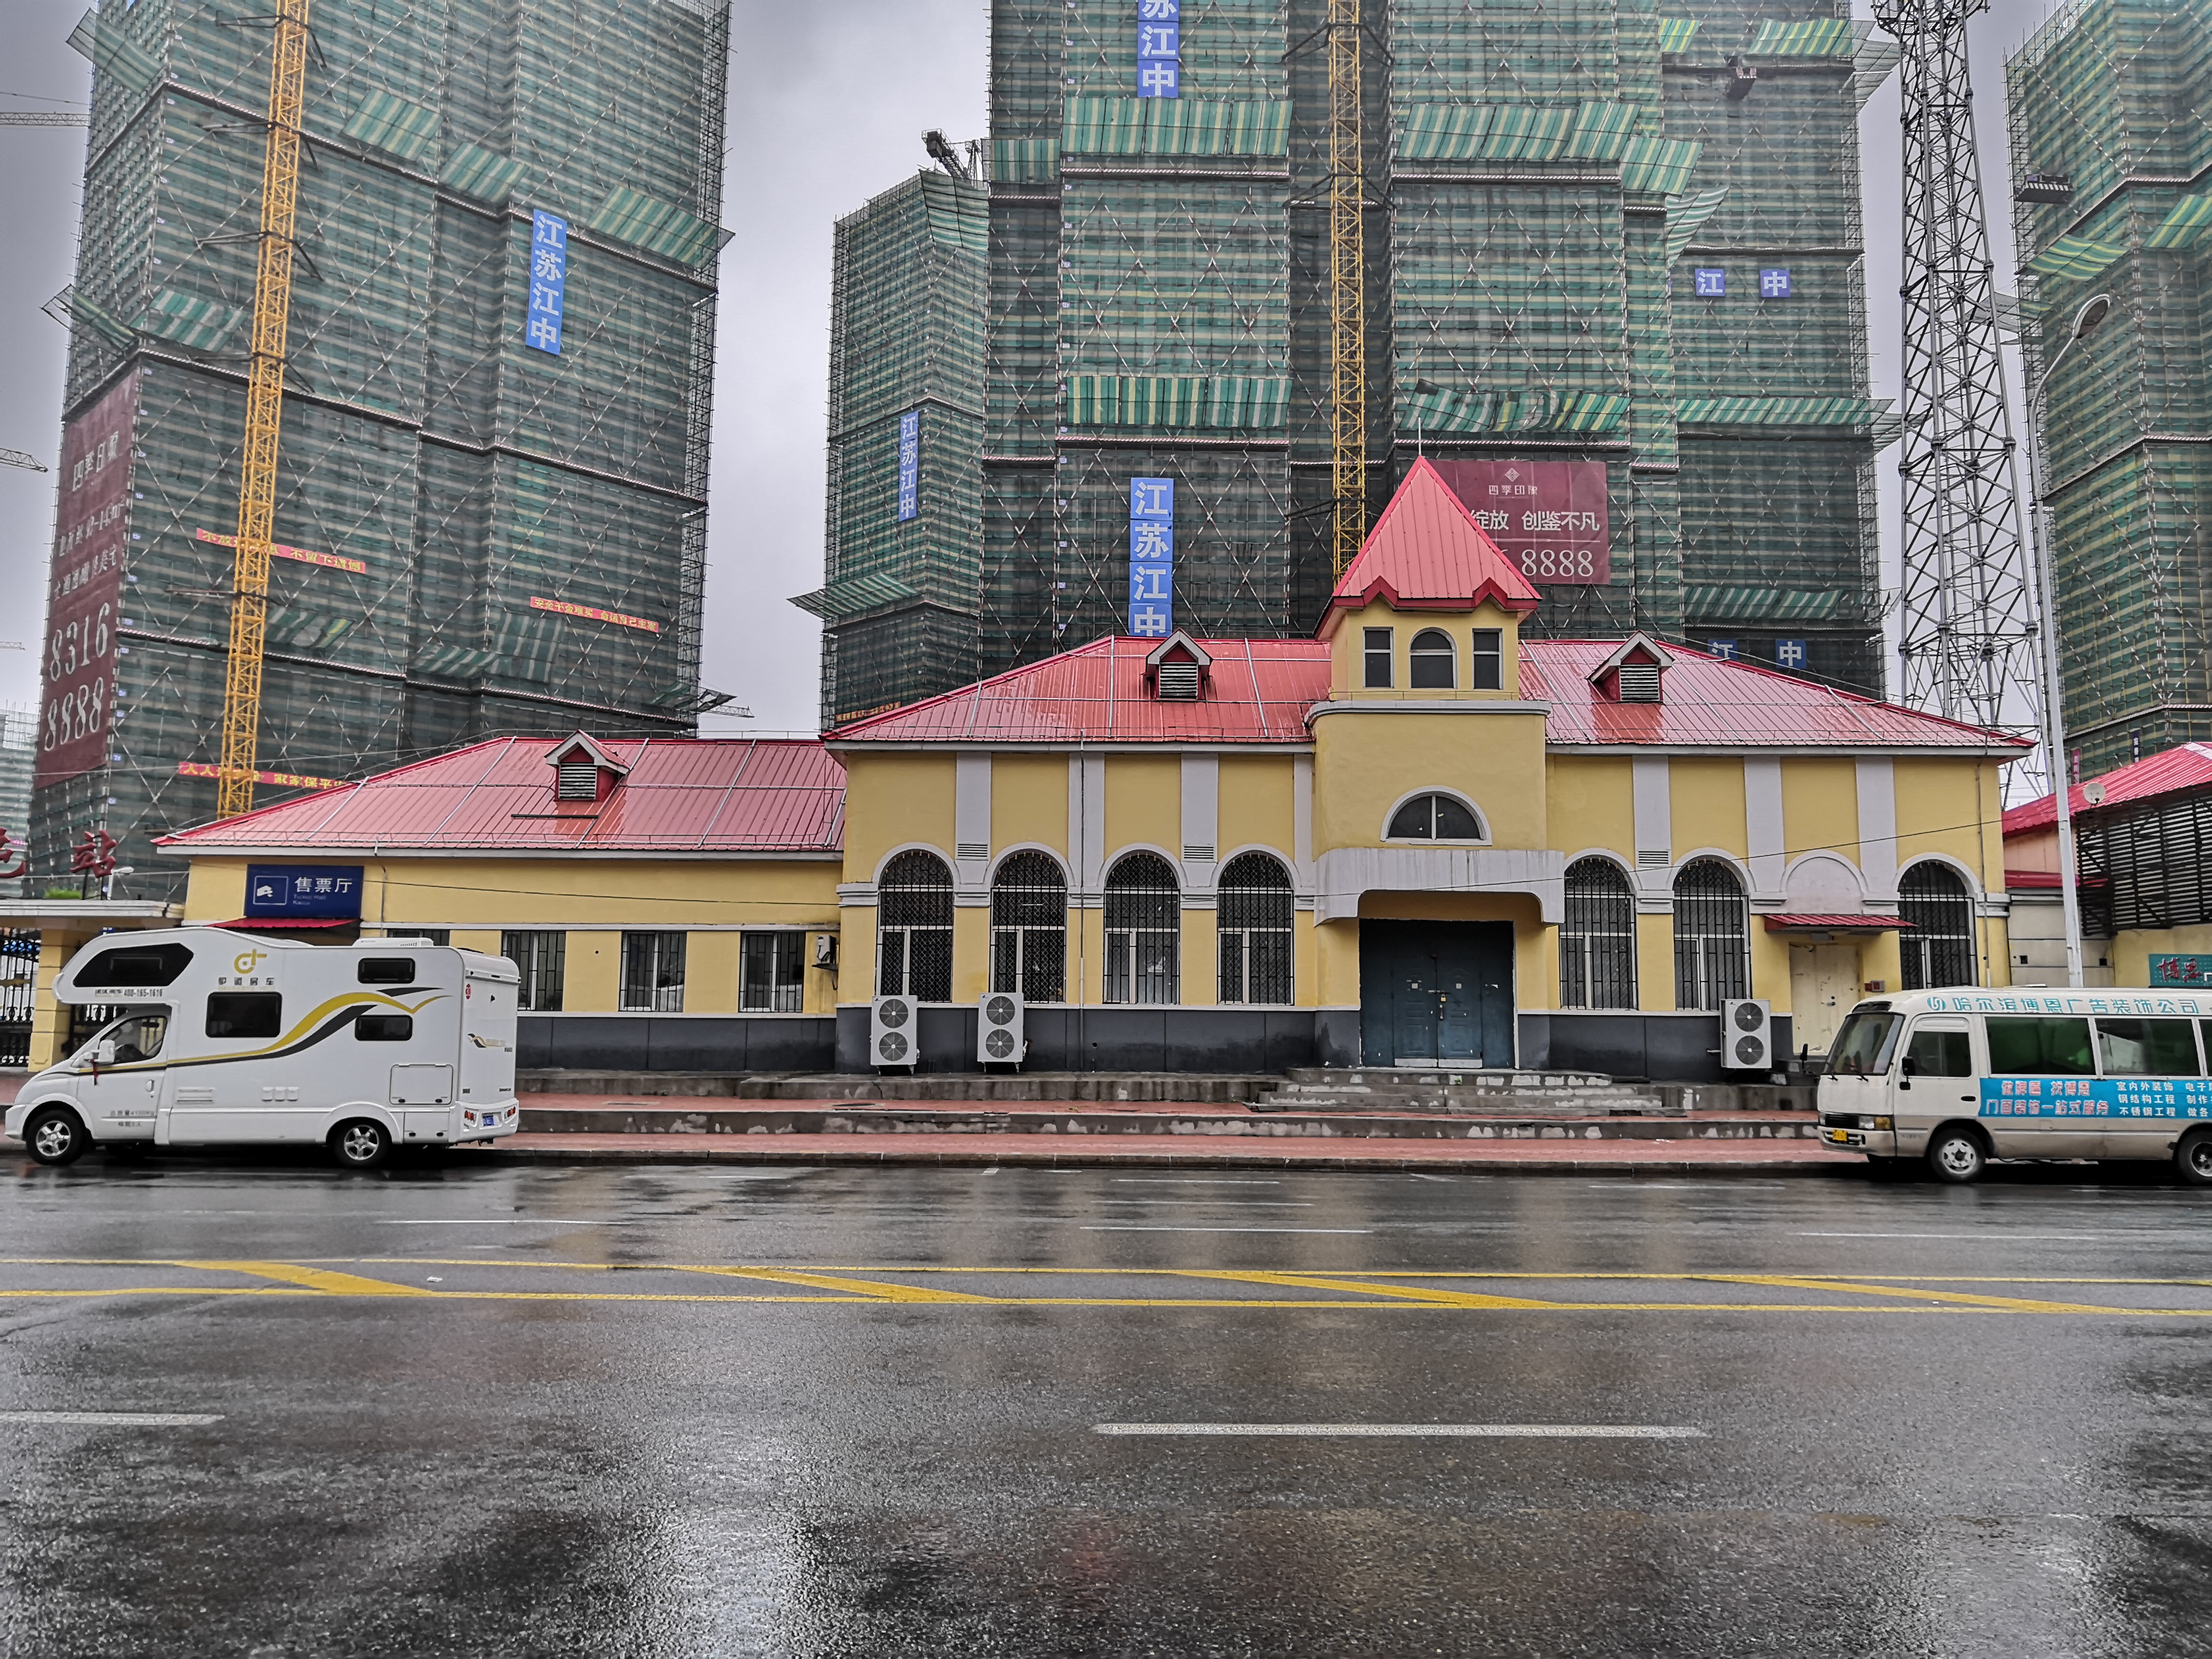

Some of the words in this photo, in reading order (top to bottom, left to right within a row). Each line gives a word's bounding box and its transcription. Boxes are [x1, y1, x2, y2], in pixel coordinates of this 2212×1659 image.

[531, 214, 563, 350] 江苏江中
[901, 416, 916, 518] 江苏江中
[1522, 510, 1600, 531] 创鉴不凡
[1134, 481, 1168, 637] 江苏江中
[1521, 549, 1593, 577] 8888
[50, 602, 110, 682] 8316
[44, 676, 104, 751] 8888
[274, 773, 342, 789] 家家保平
[294, 877, 352, 893] 售票厅
[1952, 997, 2200, 1014] 哈尔滨博恩广告装饰公司
[2116, 1081, 2174, 1091] 室内外装饰
[1986, 1099, 2109, 1116] 门面装饰一站式服务
[2118, 1094, 2176, 1105] 钢结构工程
[2186, 1094, 2212, 1105] 制作
[2119, 1106, 2176, 1117] 不锈钢工程
[2187, 1107, 2212, 1117] 做各
